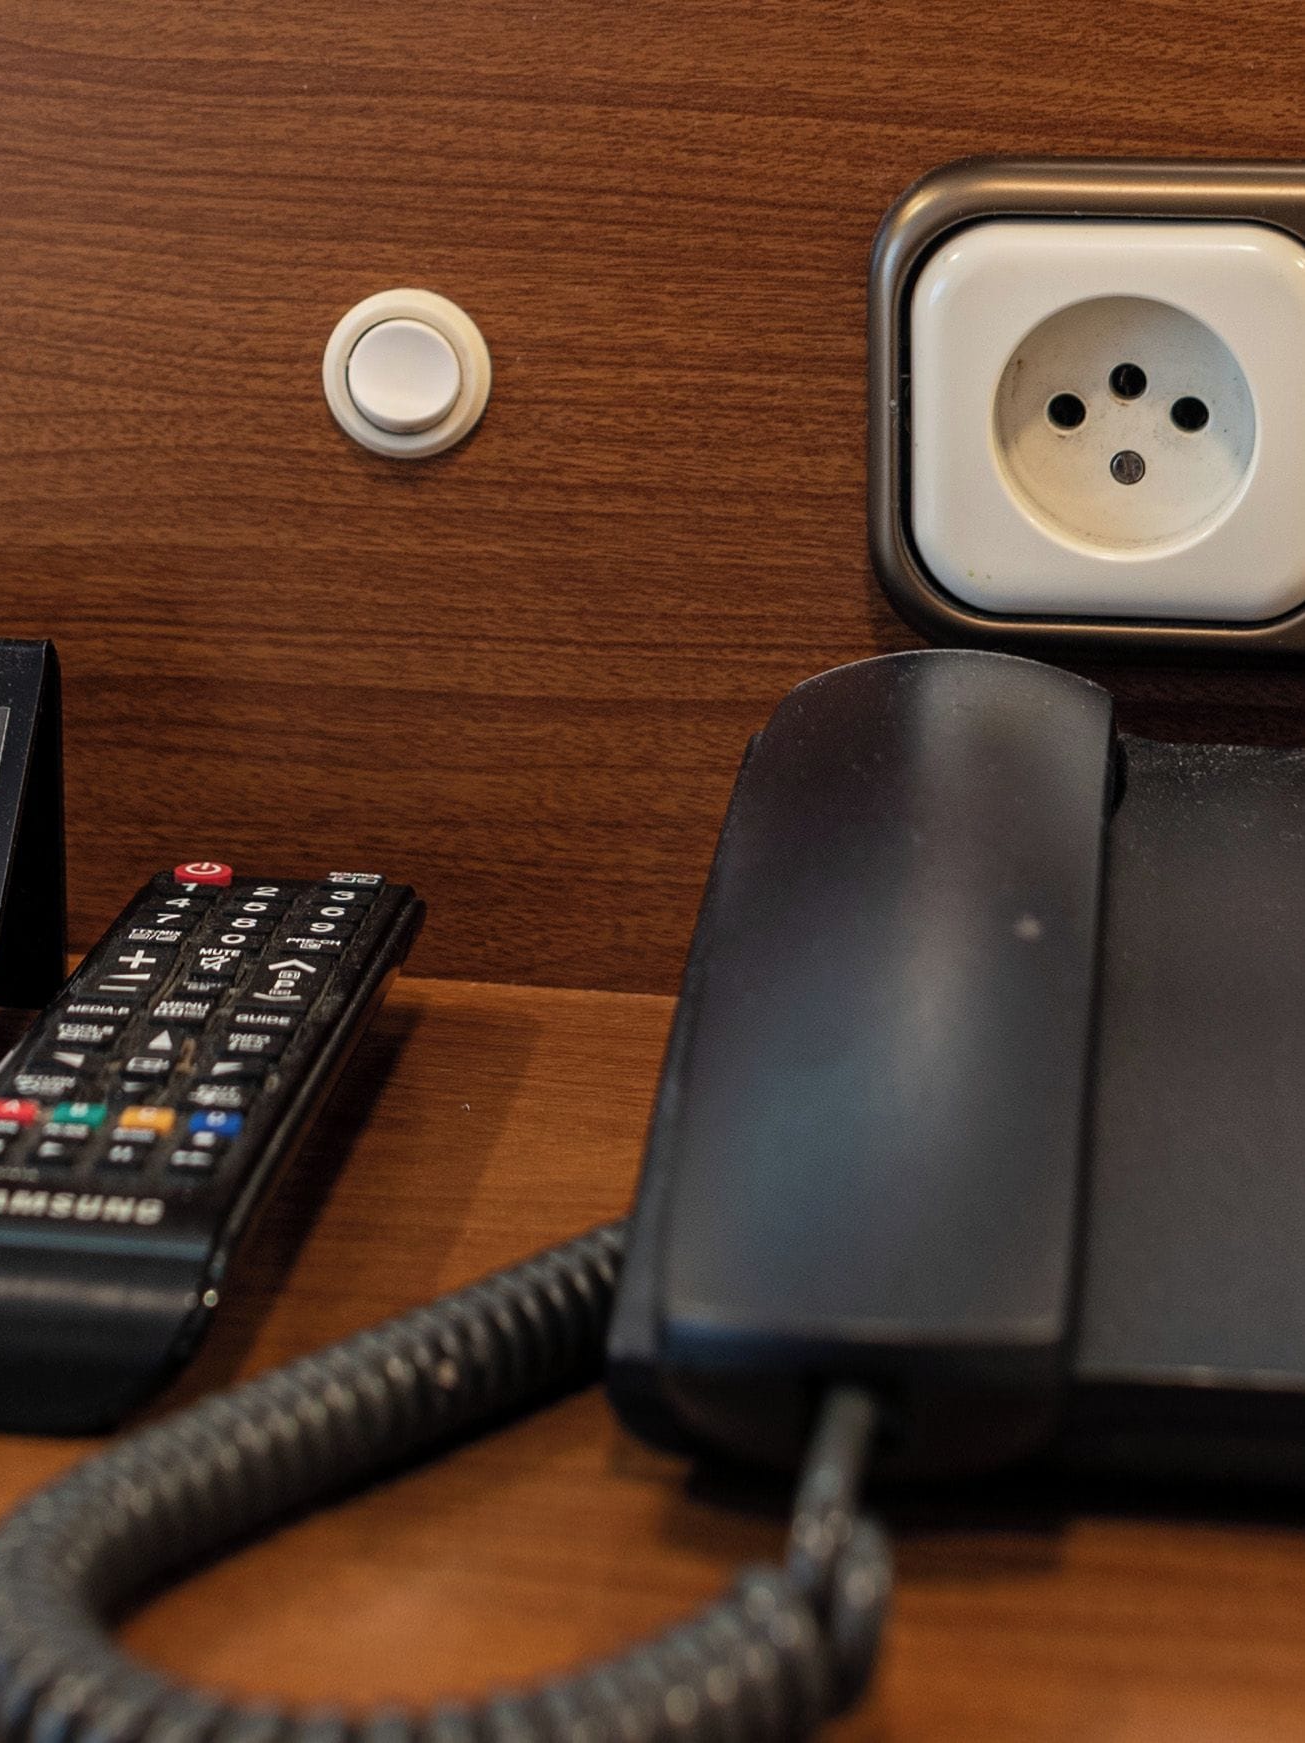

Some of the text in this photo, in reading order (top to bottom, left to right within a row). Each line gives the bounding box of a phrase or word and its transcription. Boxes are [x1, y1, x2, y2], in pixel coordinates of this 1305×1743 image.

[252, 886, 280, 897] 2
[330, 890, 355, 901] 3
[165, 898, 191, 908] 4
[243, 901, 268, 912] 5
[320, 906, 345, 917] 6
[156, 913, 182, 923] 7
[231, 917, 258, 928] 8
[309, 922, 336, 933] 9
[221, 934, 246, 945] 0
[286, 937, 342, 946] PRE-CH
[199, 947, 242, 957] MUTE
[158, 1000, 210, 1011] MENU
[235, 1013, 292, 1027] GUIDE
